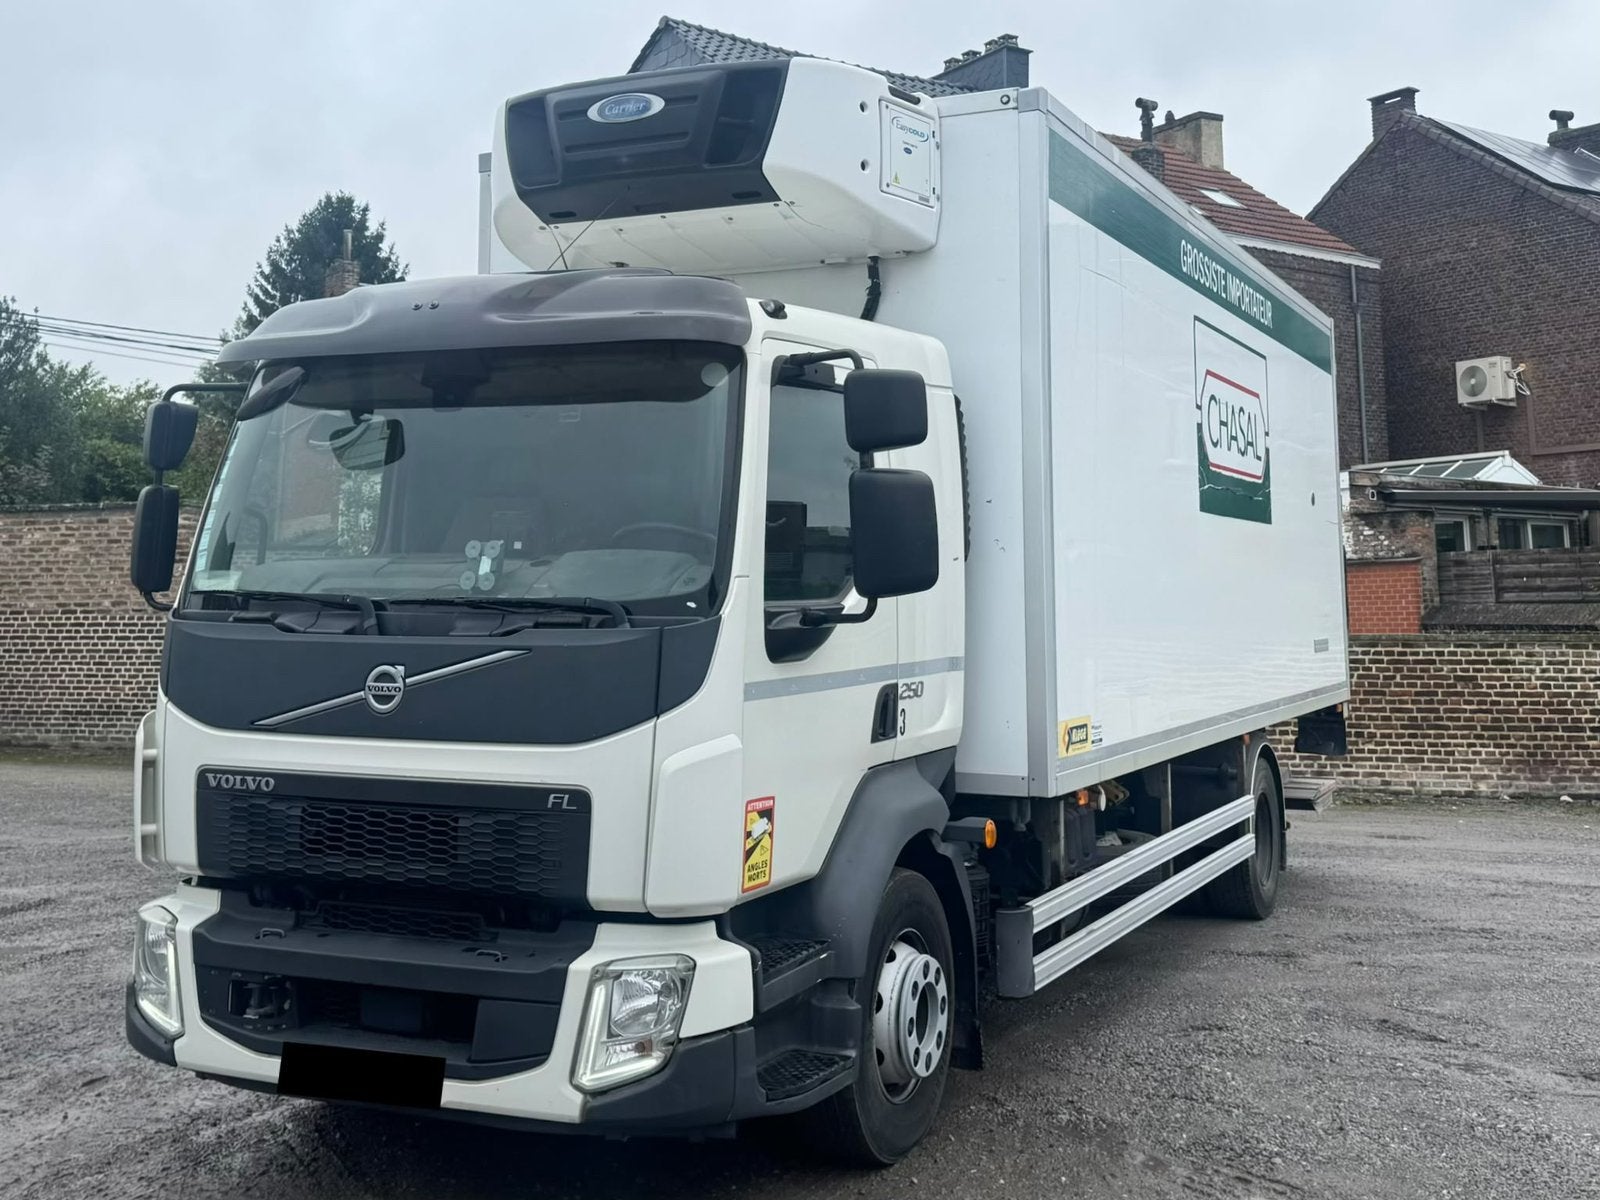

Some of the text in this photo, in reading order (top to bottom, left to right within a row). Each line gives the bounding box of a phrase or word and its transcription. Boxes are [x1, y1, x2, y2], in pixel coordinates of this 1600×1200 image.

[605, 101, 646, 115] Carrier
[1180, 239, 1273, 329] GROSSISTE IMPORTATEUR
[1207, 394, 1262, 462] CHASAL
[367, 685, 402, 693] VOLVO
[899, 681, 925, 700] 250
[899, 708, 906, 736] 3
[205, 773, 275, 792] VOLVO
[547, 793, 577, 810] FL
[747, 859, 768, 873] ANGLES
[747, 869, 767, 883] MORTS
